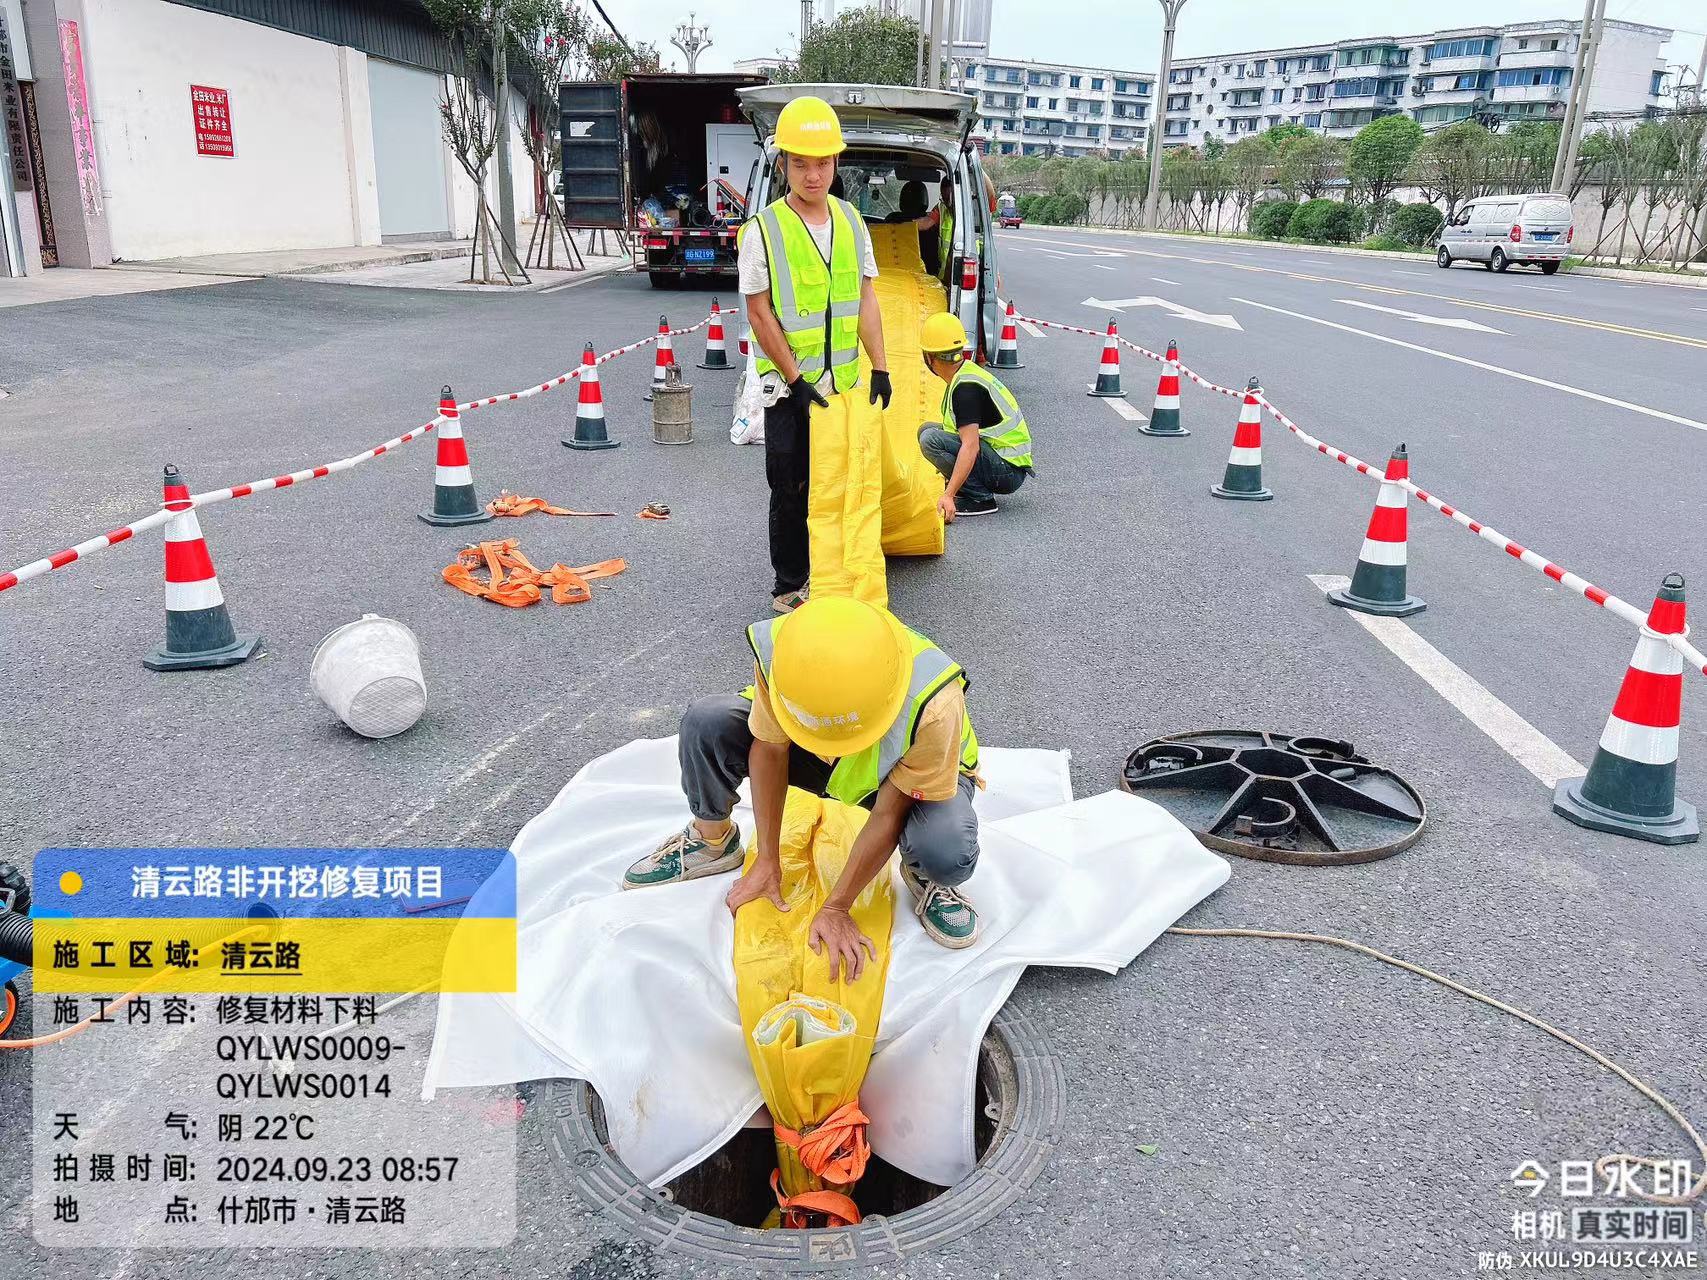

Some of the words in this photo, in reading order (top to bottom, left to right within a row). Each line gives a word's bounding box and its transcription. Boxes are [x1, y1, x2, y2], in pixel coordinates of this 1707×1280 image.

[198, 104, 225, 118] 出售转让
[199, 118, 228, 131] 证件齐全
